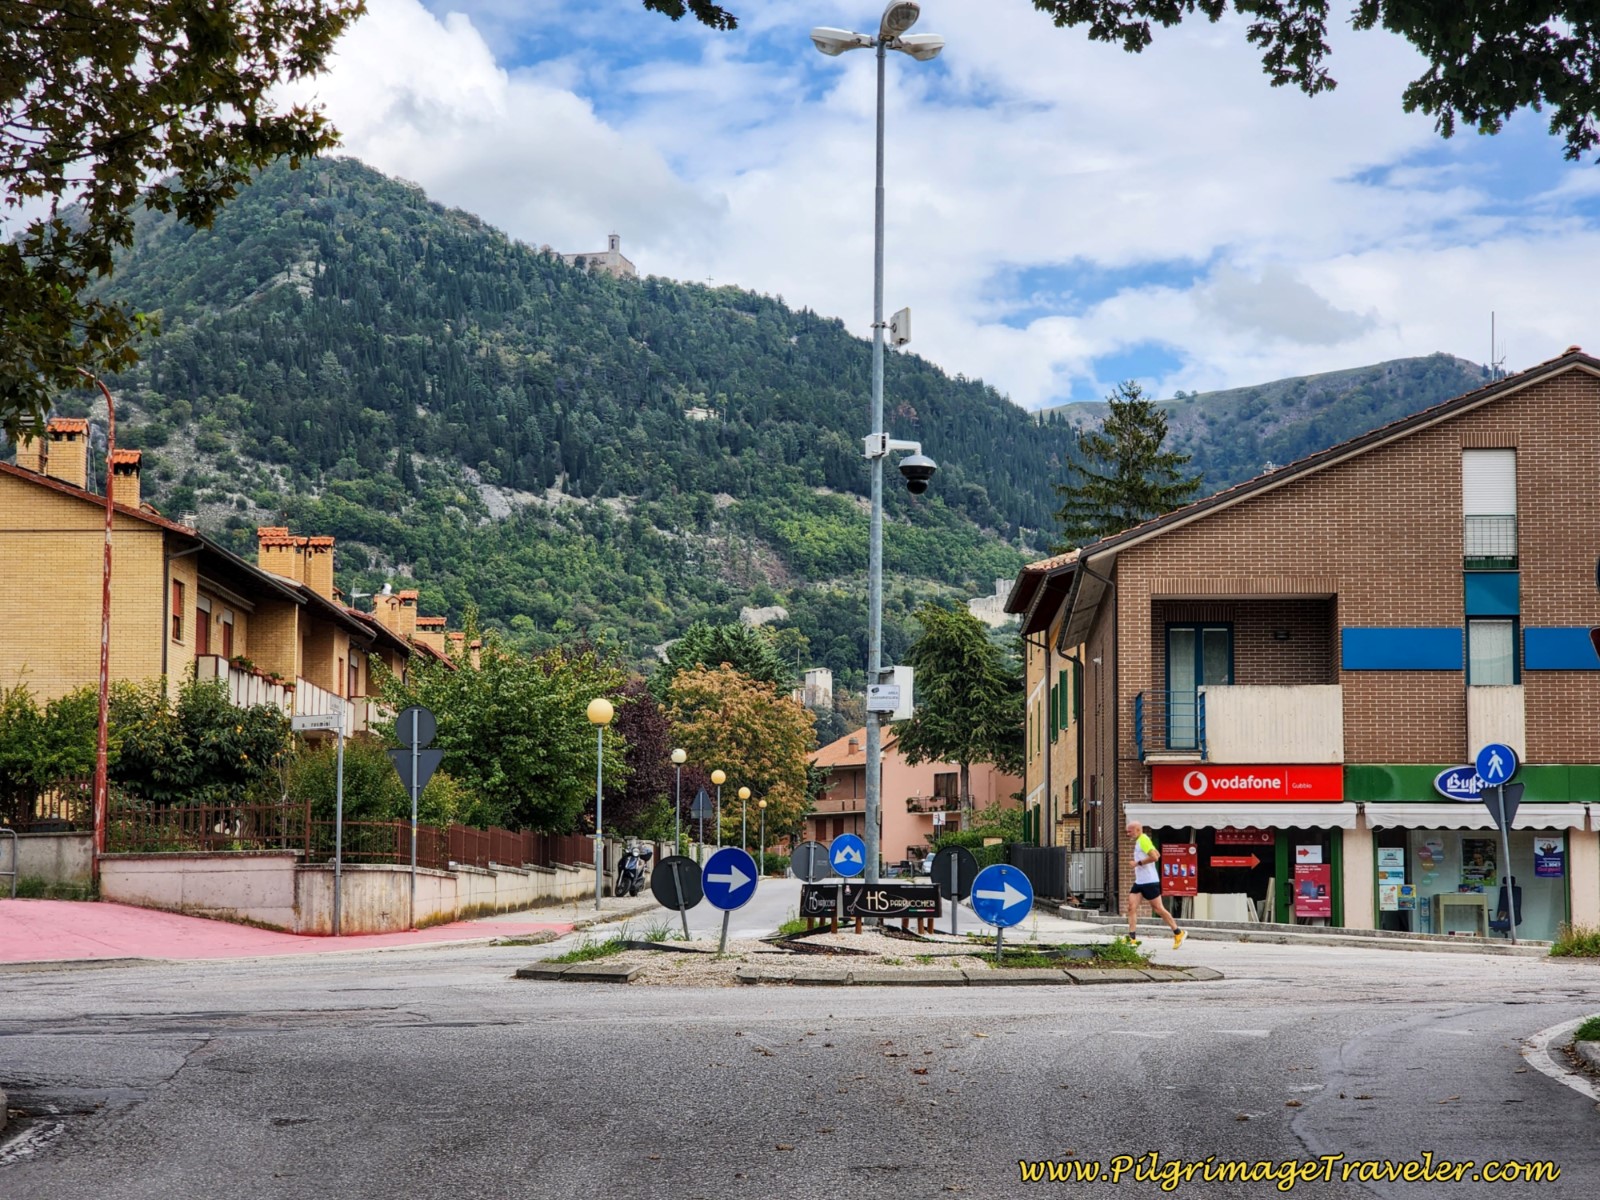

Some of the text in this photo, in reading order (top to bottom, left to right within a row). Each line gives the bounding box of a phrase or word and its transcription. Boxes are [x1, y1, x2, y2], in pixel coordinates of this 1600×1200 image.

[1211, 775, 1281, 789] vodafone
[866, 890, 936, 911] HS PARRUCCHIERI
